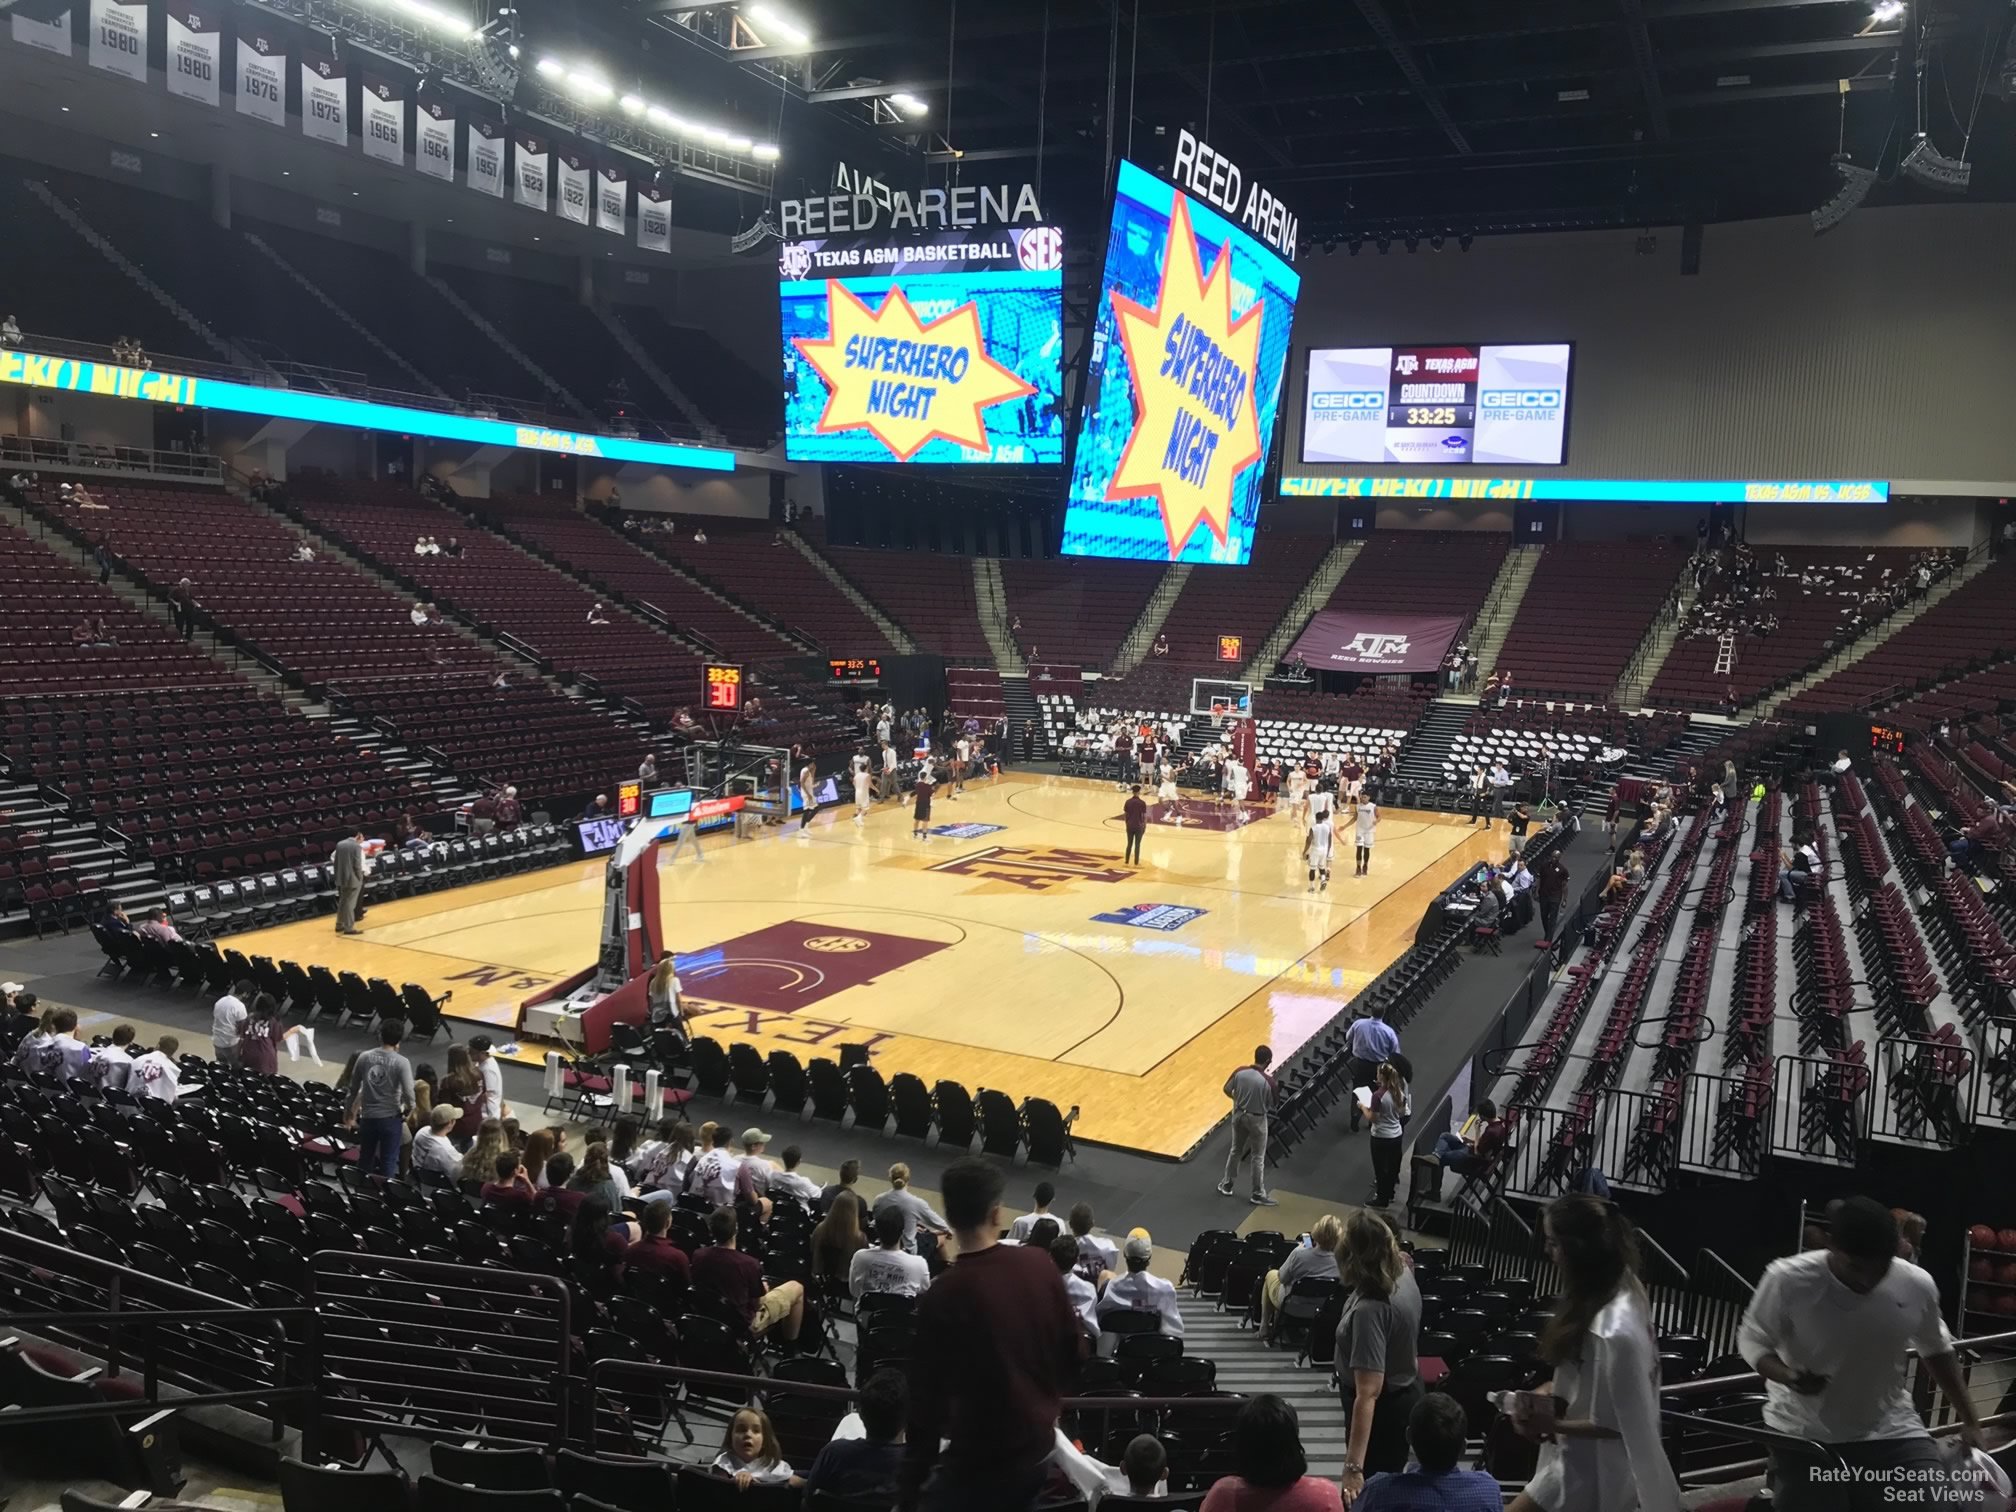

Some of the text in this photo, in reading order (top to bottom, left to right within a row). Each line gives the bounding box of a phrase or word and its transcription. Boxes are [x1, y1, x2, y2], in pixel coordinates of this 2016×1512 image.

[100, 26, 138, 55] 1980
[176, 54, 211, 80] 1980
[245, 75, 278, 102] 1976
[311, 99, 340, 123] 1975
[370, 120, 397, 144] 1969
[423, 138, 449, 161] 1964
[475, 156, 498, 178] 1951
[1172, 128, 1298, 261] REED ARENA
[780, 184, 1043, 236] REED ARENA
[643, 219, 666, 236] 1920
[814, 243, 1012, 267] TEXAS A&M BASKETBALL
[1020, 227, 1062, 271] SEC
[844, 333, 970, 384] SUPERHERO
[1425, 358, 1454, 370] TEXAS
[90, 364, 197, 405] NIGHT
[1160, 313, 1247, 432] SUPERHERO
[866, 379, 937, 421] NIGHT
[1312, 393, 1383, 408] GEICO
[1401, 383, 1466, 398] COUNTDOWN
[1482, 392, 1559, 408] GEICO
[1313, 410, 1380, 422] PRE-GAME
[1407, 408, 1456, 425] 33:25
[1483, 409, 1556, 421] PRE-GAME
[1161, 406, 1220, 490] NIGHT
[1280, 478, 1534, 499] SUPER HERO NIGHT
[1222, 647, 1237, 658] 30
[708, 668, 739, 683] 33:25
[711, 682, 736, 706] 30
[622, 797, 636, 813] 30
